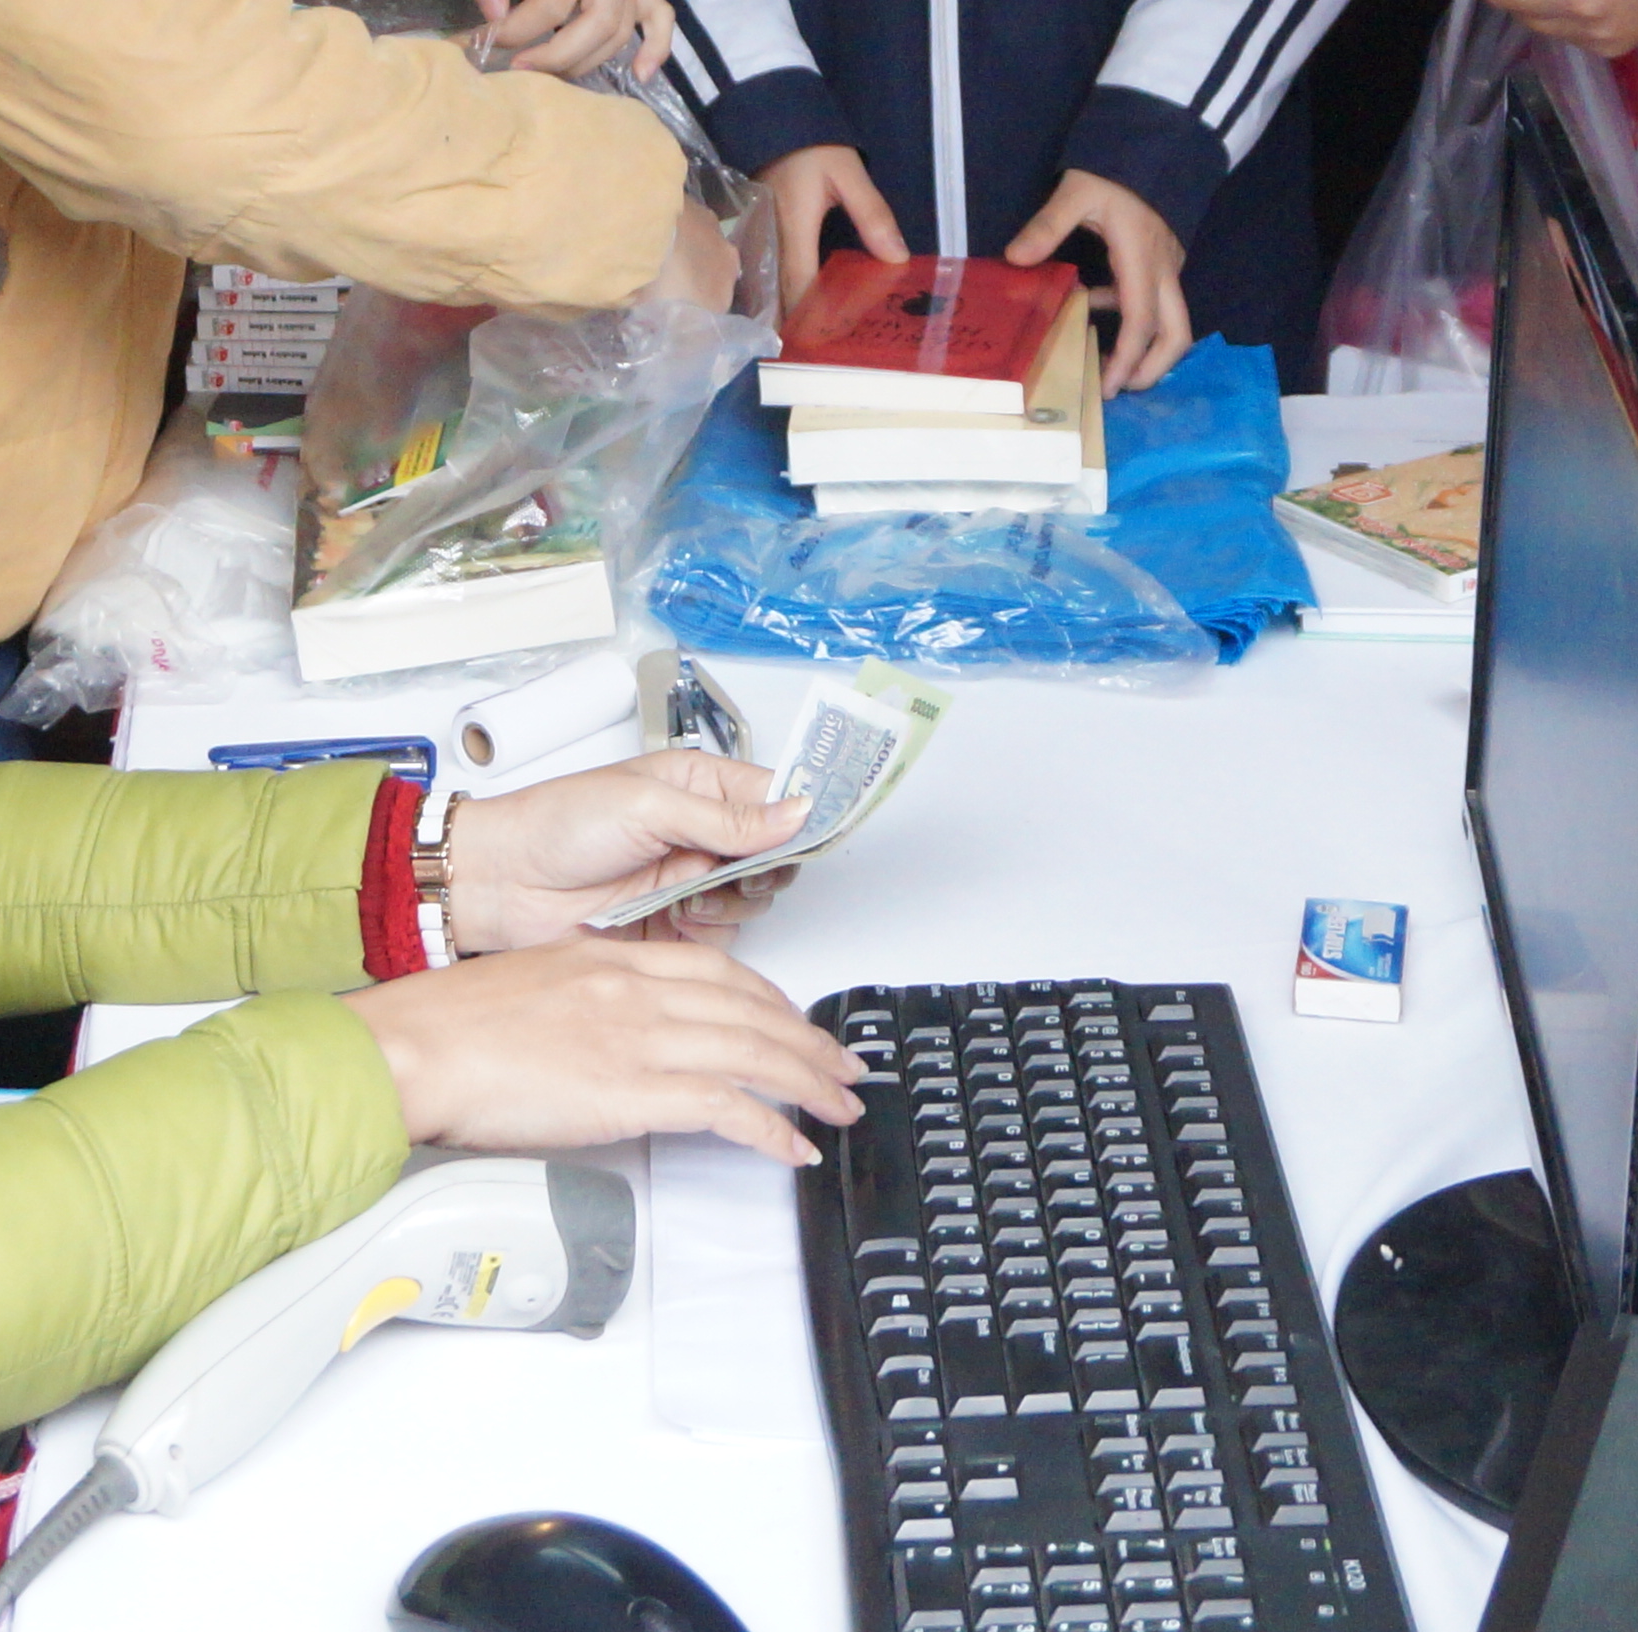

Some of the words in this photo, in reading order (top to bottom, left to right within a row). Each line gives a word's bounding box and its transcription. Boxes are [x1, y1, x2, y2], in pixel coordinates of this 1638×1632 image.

[810, 712, 844, 769] 5000
[863, 736, 897, 788] 5000
[1044, 1016, 1060, 1025] Q
[990, 1023, 1003, 1032] A
[1084, 1026, 1099, 1035] 2
[935, 1037, 949, 1046] Z
[938, 1062, 952, 1070] X
[1054, 1064, 1069, 1073] E
[942, 1088, 957, 1097] C
[1002, 1098, 1017, 1107] F
[1101, 1102, 1115, 1111] 5
[945, 1114, 960, 1123] V
[1065, 1117, 1080, 1126] T
[1006, 1125, 1021, 1135] G
[1106, 1129, 1121, 1137] 6
[1069, 1144, 1085, 1153] Y
[1074, 1171, 1090, 1181] U
[1015, 1181, 1030, 1189] J
[1024, 1238, 1039, 1248] L
[1342, 1559, 1367, 1591] K120
[1010, 1583, 1030, 1595] 2
[1081, 1579, 1101, 1591] 5
